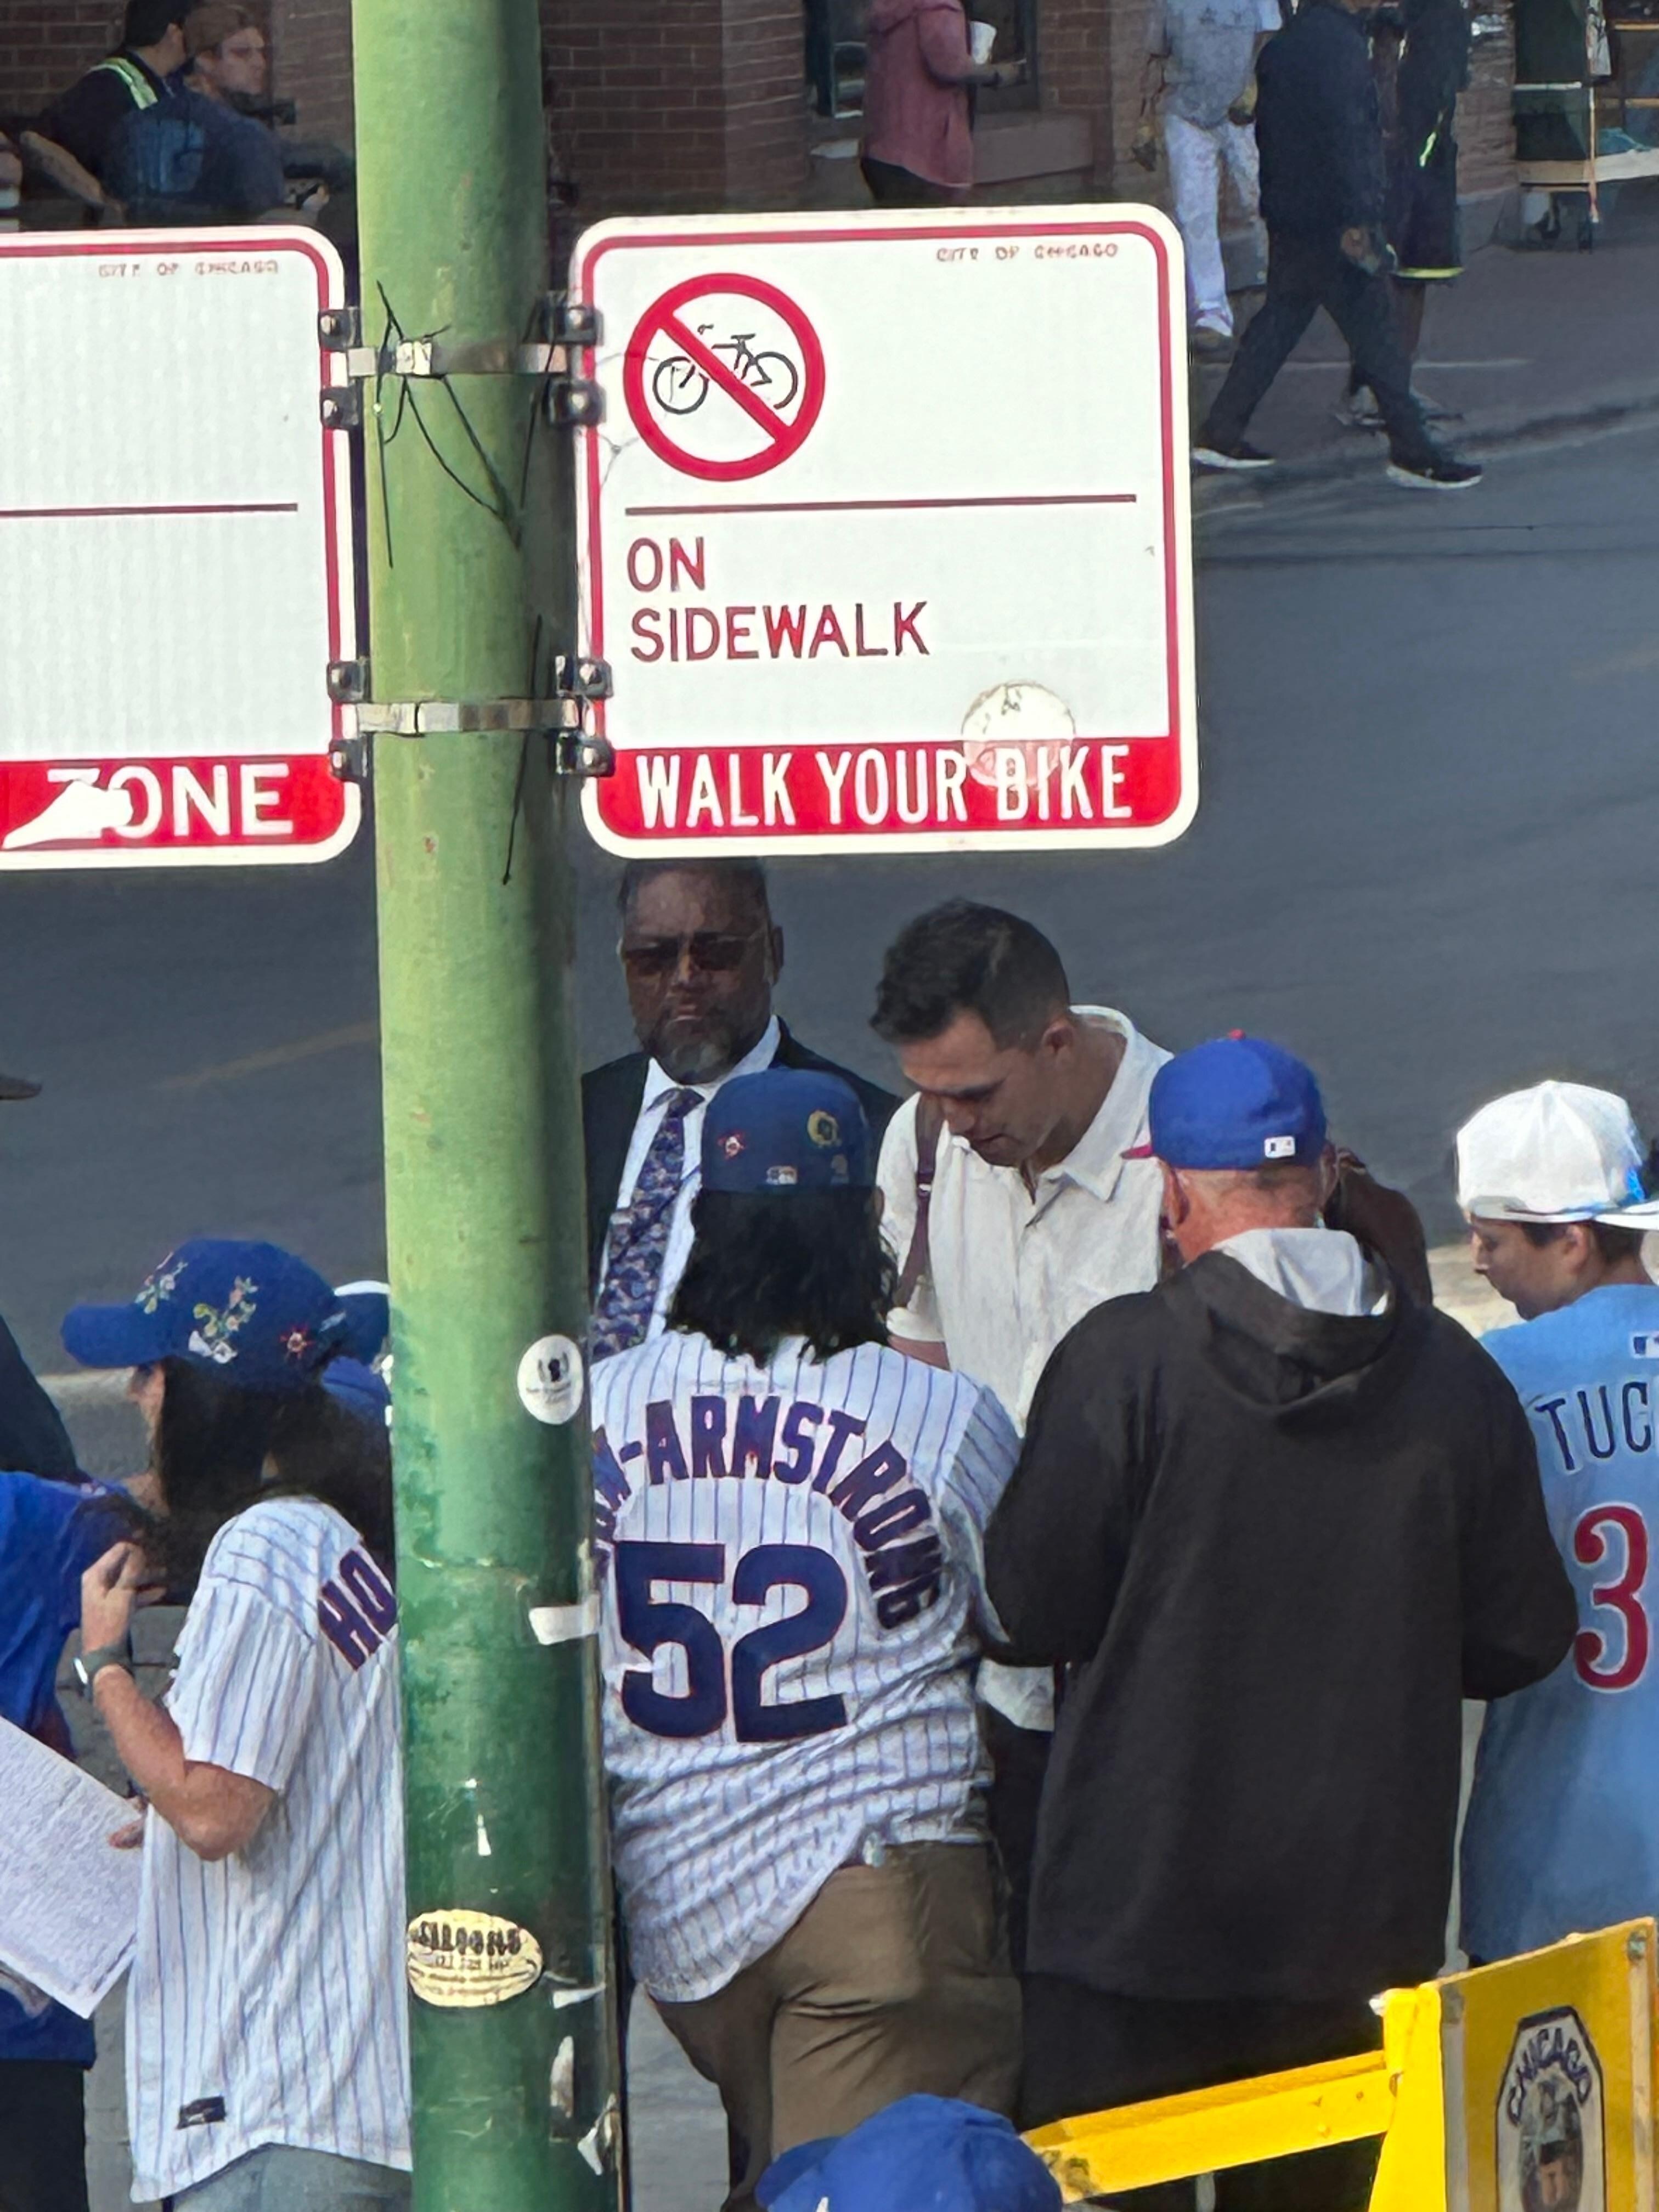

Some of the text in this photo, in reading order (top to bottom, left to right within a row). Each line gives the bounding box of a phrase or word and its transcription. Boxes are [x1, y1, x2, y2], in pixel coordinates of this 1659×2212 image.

[627, 536, 706, 592] ON
[630, 601, 930, 662] SIDEWALK
[635, 743, 1133, 829] WALK YOUR BIKE
[1573, 1505, 1649, 1690] 3
[614, 1539, 849, 1743] 52
